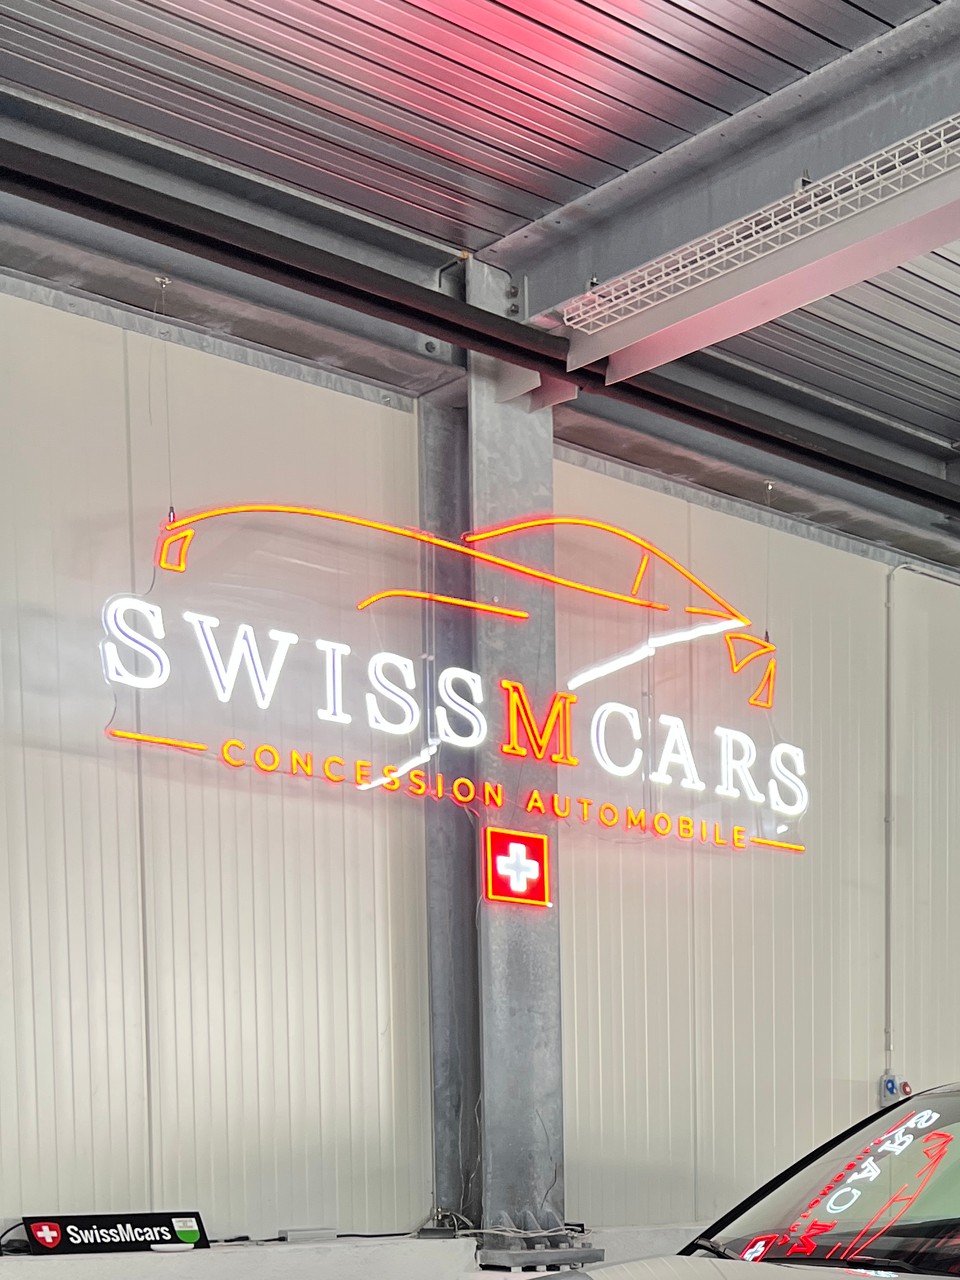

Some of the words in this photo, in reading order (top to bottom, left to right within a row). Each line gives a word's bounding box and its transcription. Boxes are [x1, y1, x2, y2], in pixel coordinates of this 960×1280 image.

[221, 739, 505, 808] CONCESSION
[526, 788, 747, 848] AUTOMOBILE
[66, 1223, 172, 1244] SwissMcars
